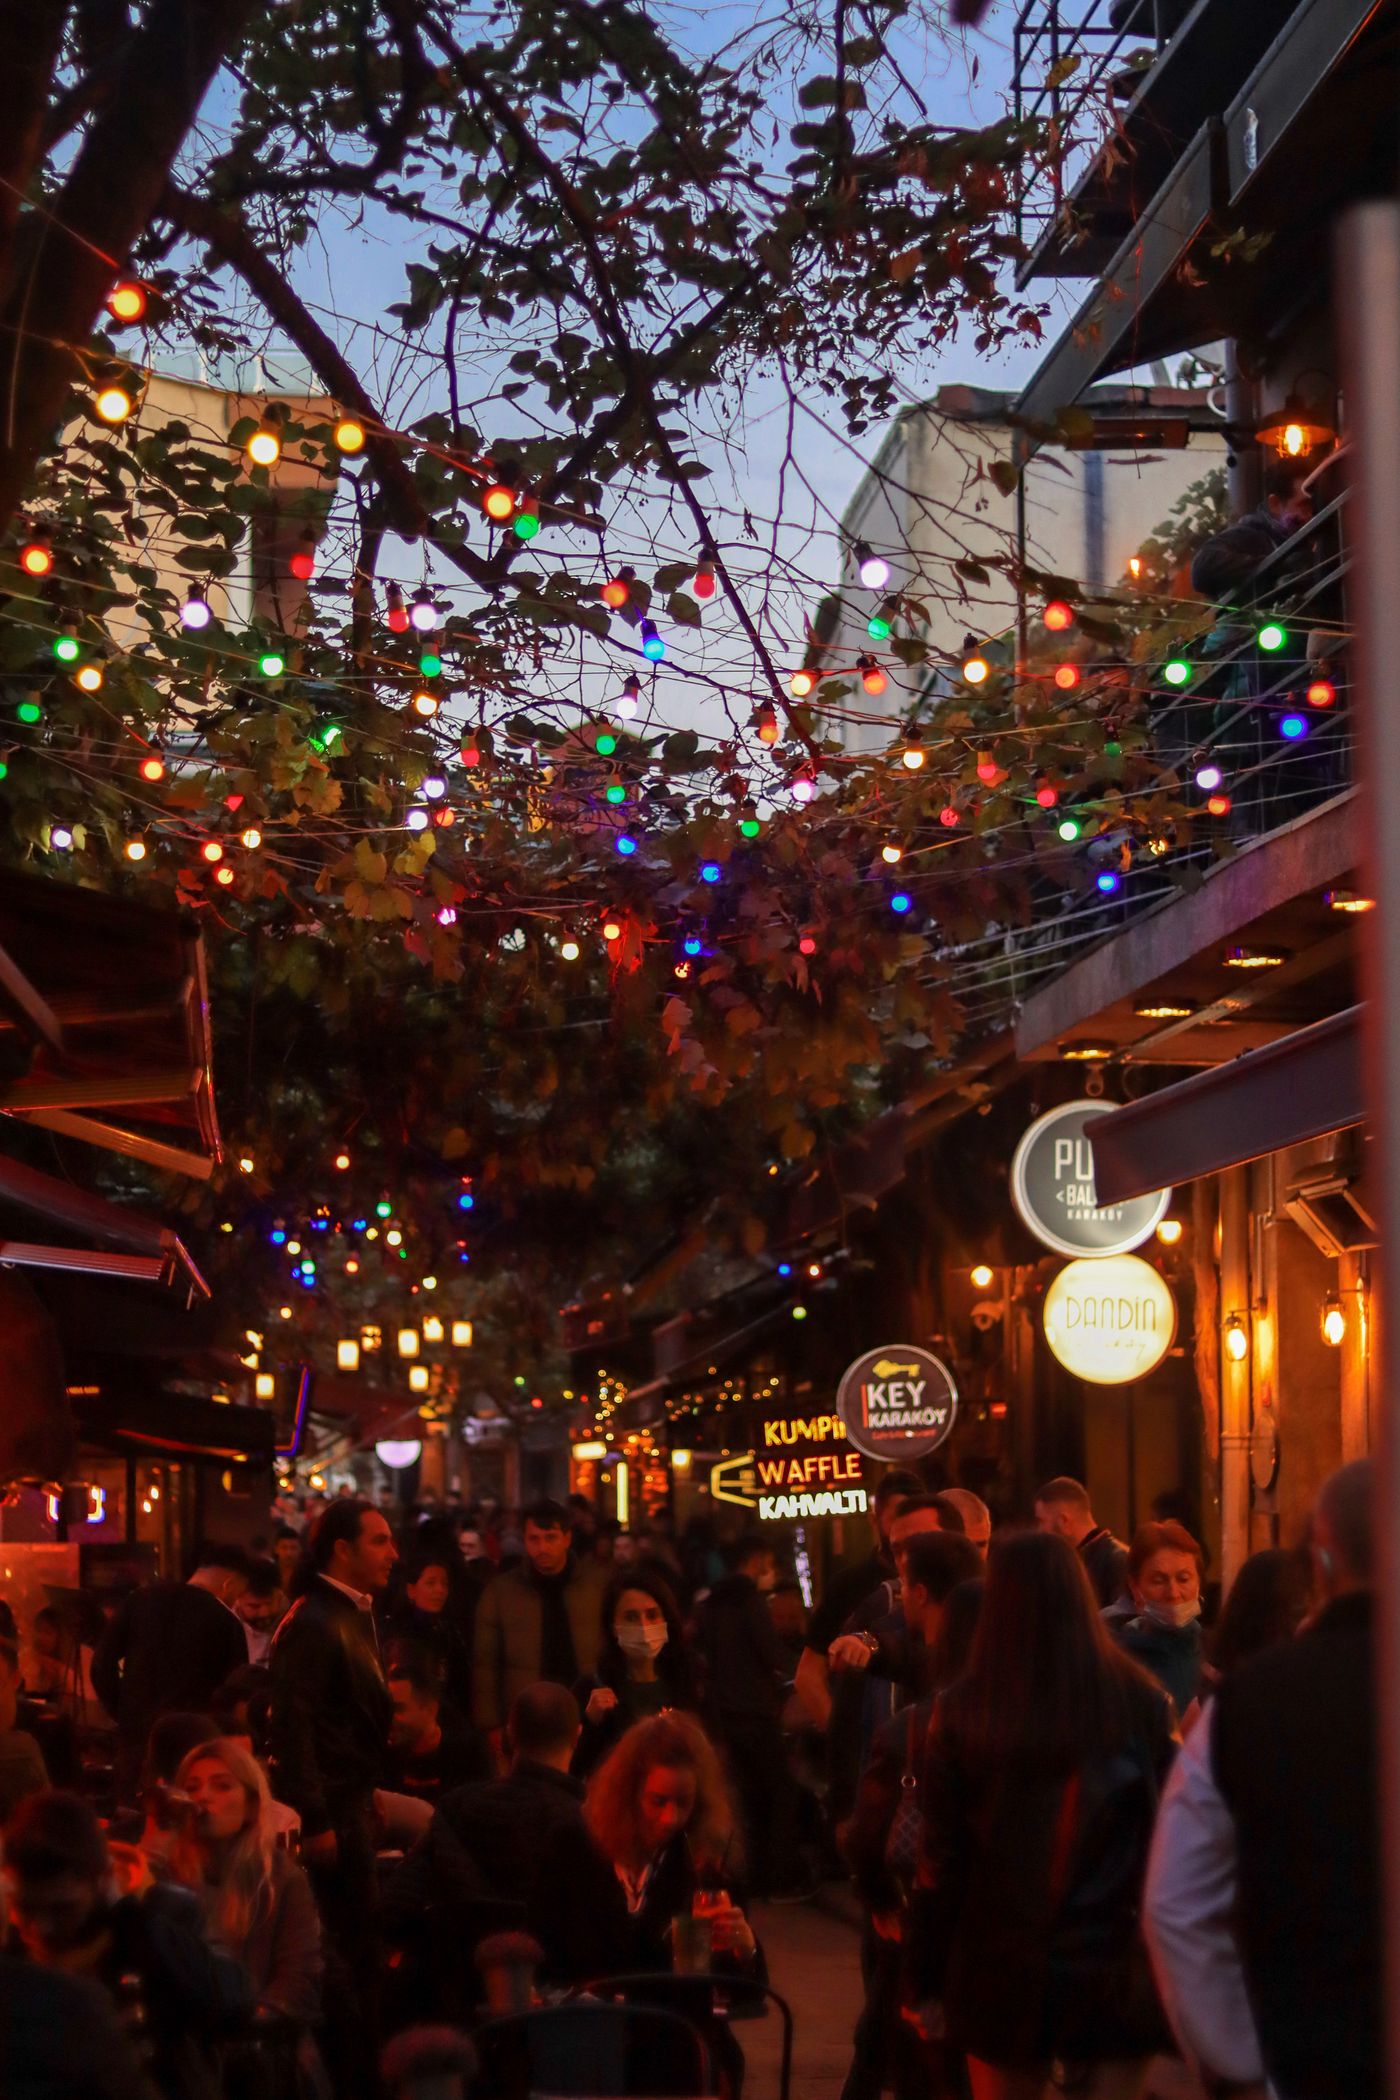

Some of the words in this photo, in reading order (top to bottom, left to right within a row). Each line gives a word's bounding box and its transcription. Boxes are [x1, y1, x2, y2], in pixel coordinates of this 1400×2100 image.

[1055, 1138, 1094, 1180] PU
[867, 1380, 926, 1409] KEY
[764, 1415, 846, 1446] KUMPİ
[758, 1453, 862, 1486] WAFFLE
[759, 1490, 867, 1519] KAHVALTI
